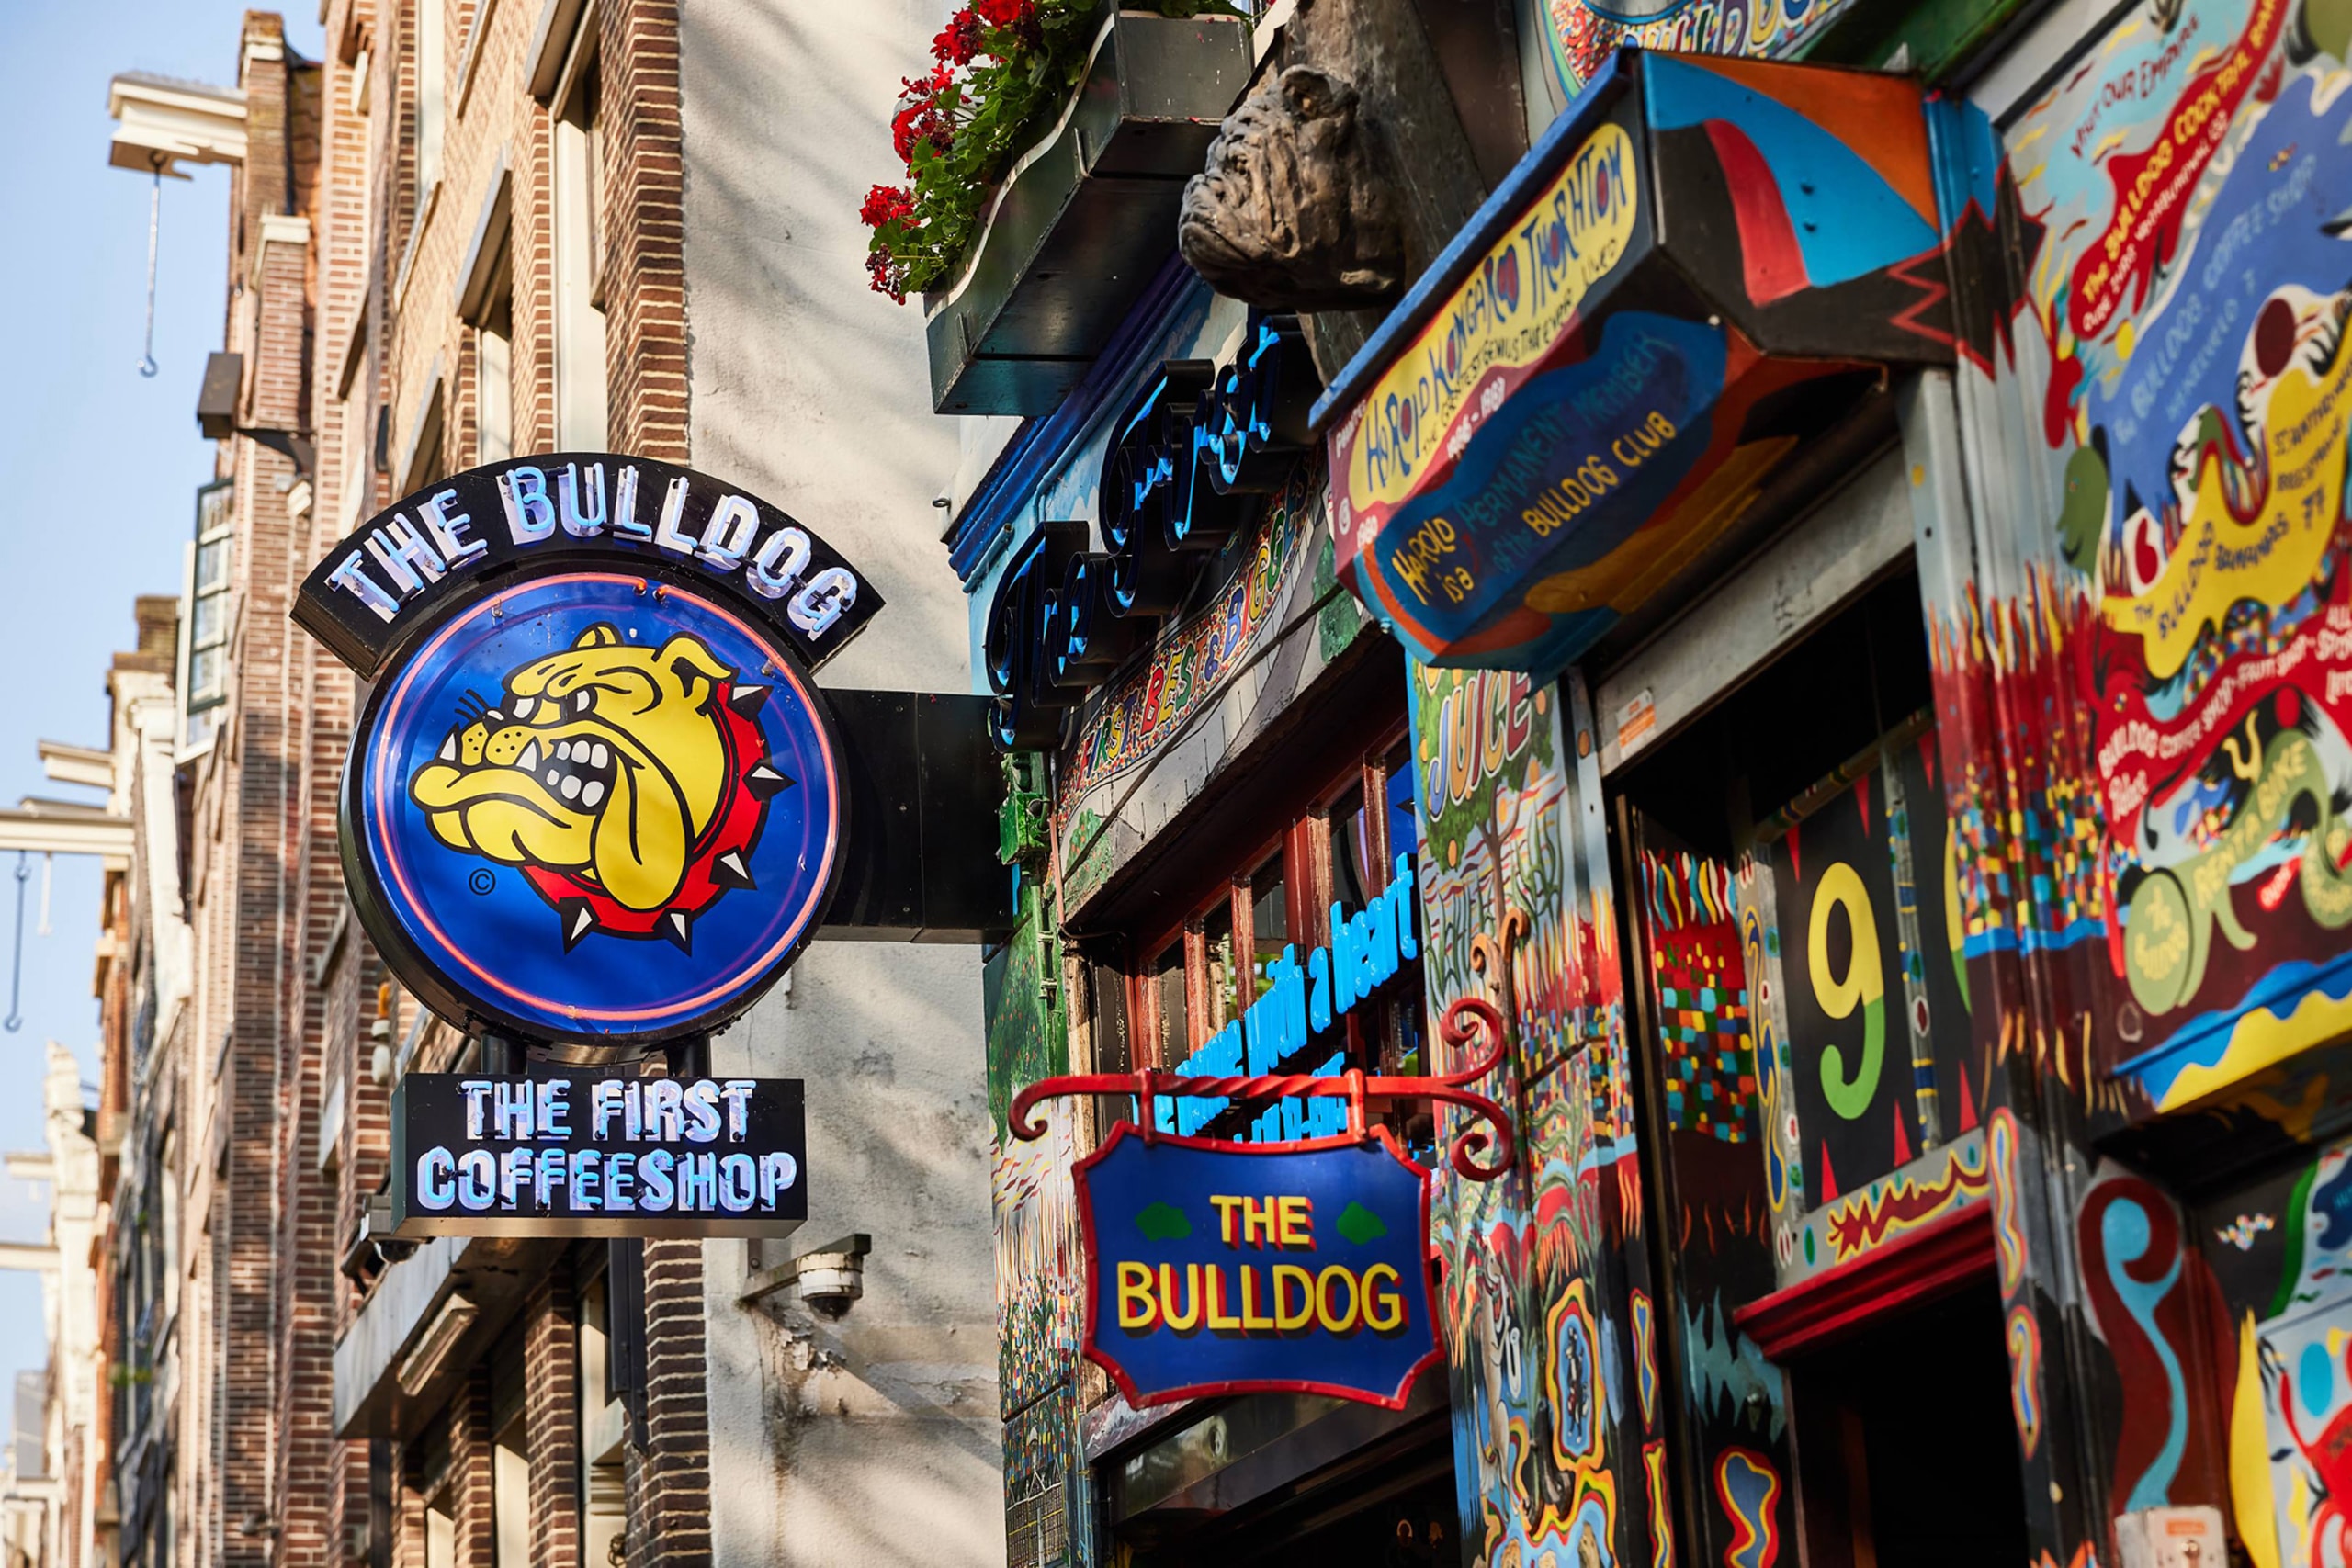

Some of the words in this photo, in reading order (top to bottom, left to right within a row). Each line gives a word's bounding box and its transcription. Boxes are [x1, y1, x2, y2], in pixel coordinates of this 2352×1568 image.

[2102, 69, 2135, 108] OUR
[2104, 139, 2173, 263] BULLDOG
[2131, 291, 2203, 420] BULLDOG
[2202, 201, 2264, 291] COFFEE
[2267, 153, 2317, 226] SHOP
[1453, 402, 1573, 535] PERMANENT
[1571, 329, 1672, 429] MEMBER
[1521, 455, 1619, 538] BULLDOG
[1611, 410, 1677, 468] CLUB
[324, 485, 489, 623] THE
[496, 461, 858, 641] BULLDOG
[1391, 516, 1457, 606] HAROLD
[1076, 687, 1138, 792] FIRST
[1140, 631, 1211, 737] BEST
[1427, 663, 1532, 823] JUICE
[2098, 719, 2159, 780] BULLDOG
[2159, 718, 2203, 761] COFFEE
[2201, 676, 2233, 732] SHOP
[2276, 634, 2308, 678] SHOP
[2257, 739, 2308, 821] BIKE
[1329, 852, 1418, 1015] heart
[1807, 861, 1886, 1120] 9
[458, 1079, 573, 1141] THE
[591, 1079, 758, 1142] FIRST
[416, 1145, 798, 1212] COFFEESHOP
[1209, 1194, 1317, 1252] THE
[1116, 1260, 1409, 1340] BULLDOG
